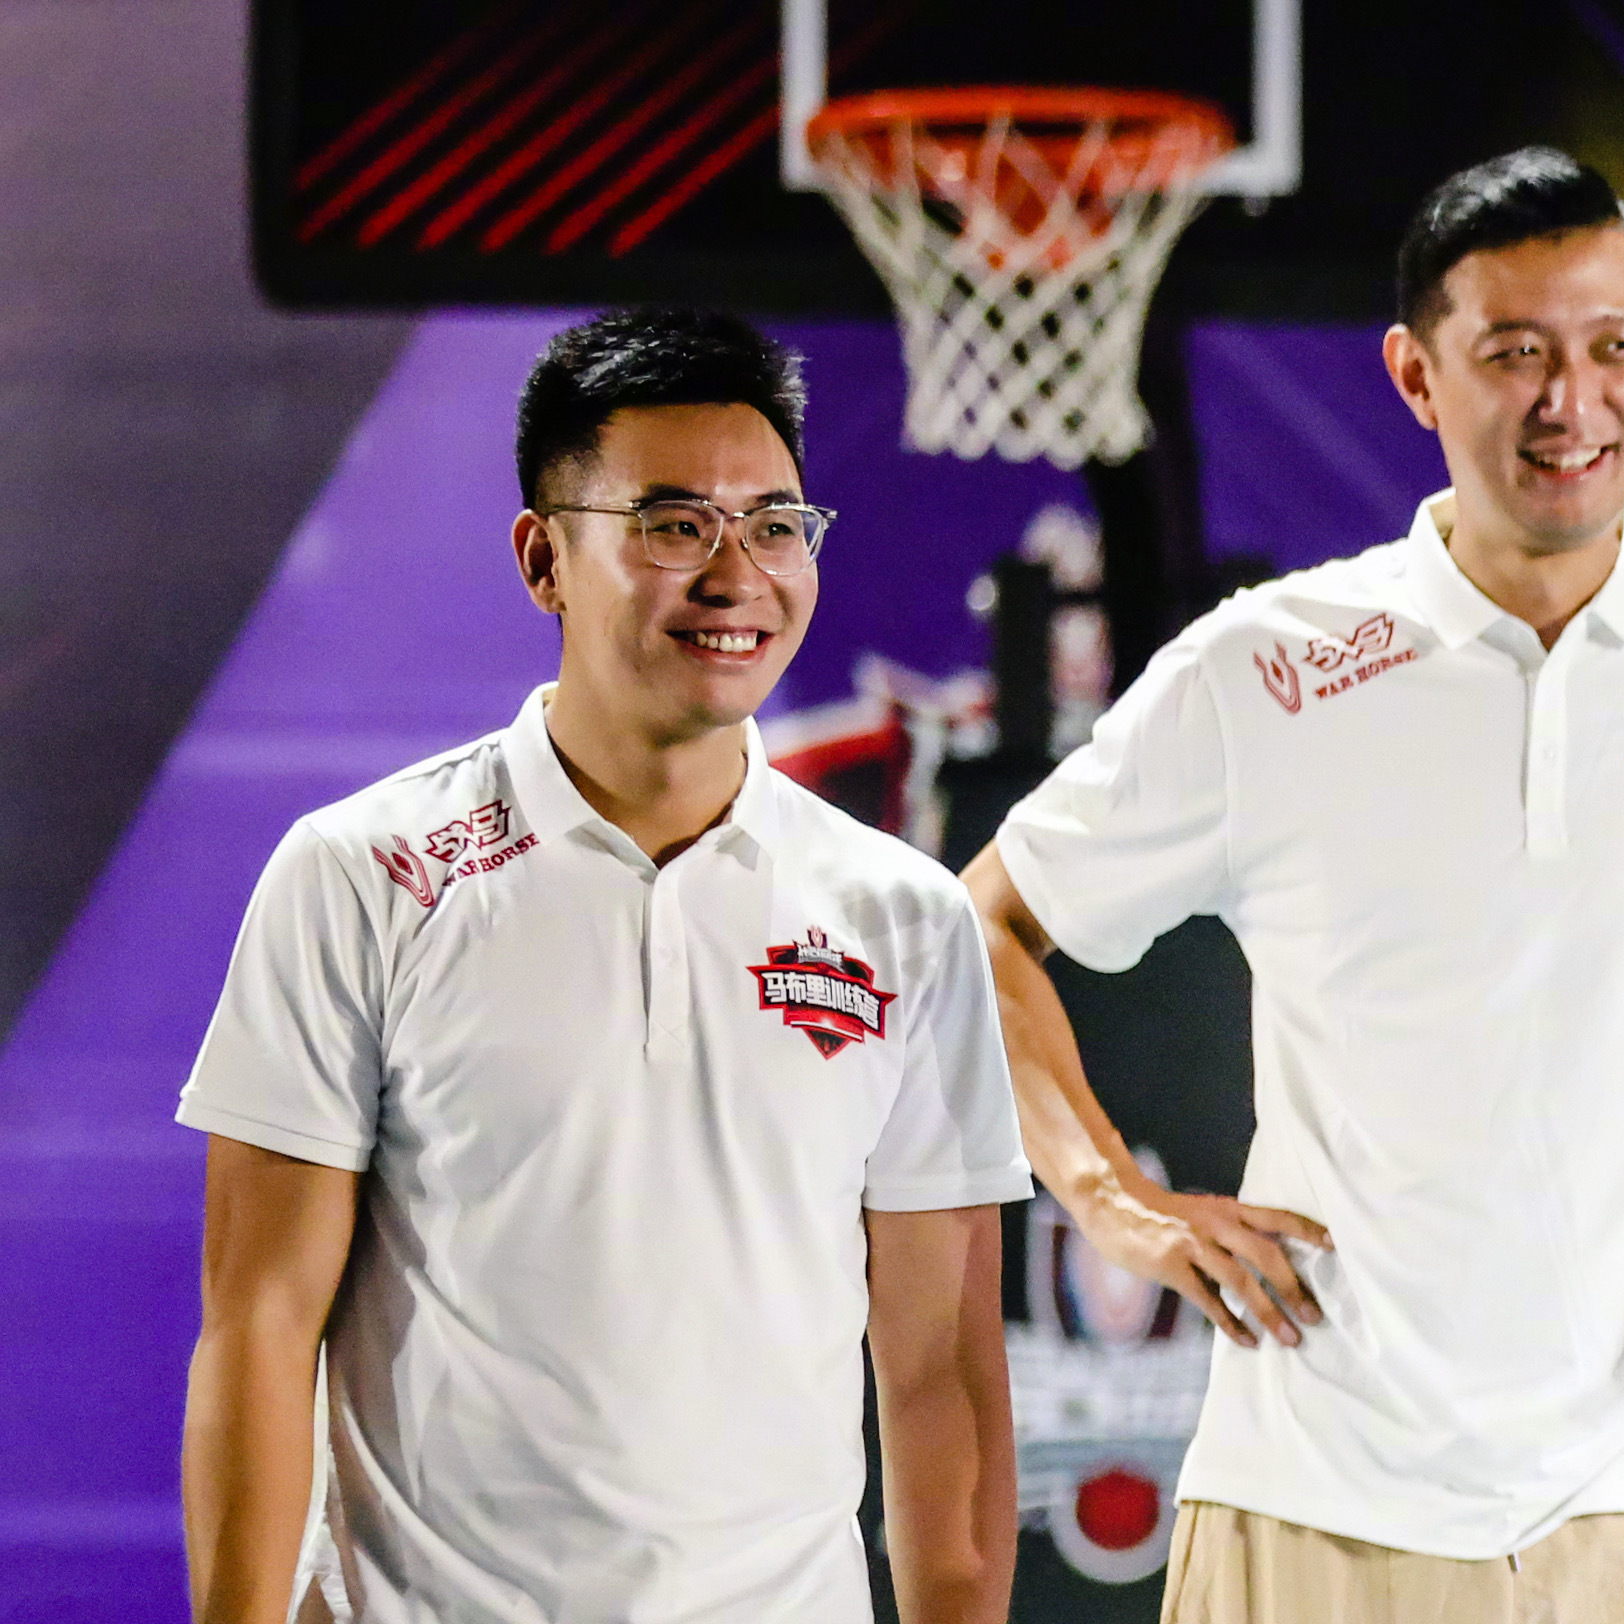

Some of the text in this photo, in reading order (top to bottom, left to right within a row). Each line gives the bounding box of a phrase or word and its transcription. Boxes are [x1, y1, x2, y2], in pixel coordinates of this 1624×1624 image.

[1314, 676, 1354, 700] WAR
[479, 833, 541, 873] HORSE
[761, 972, 880, 1030] 马布里训练营
